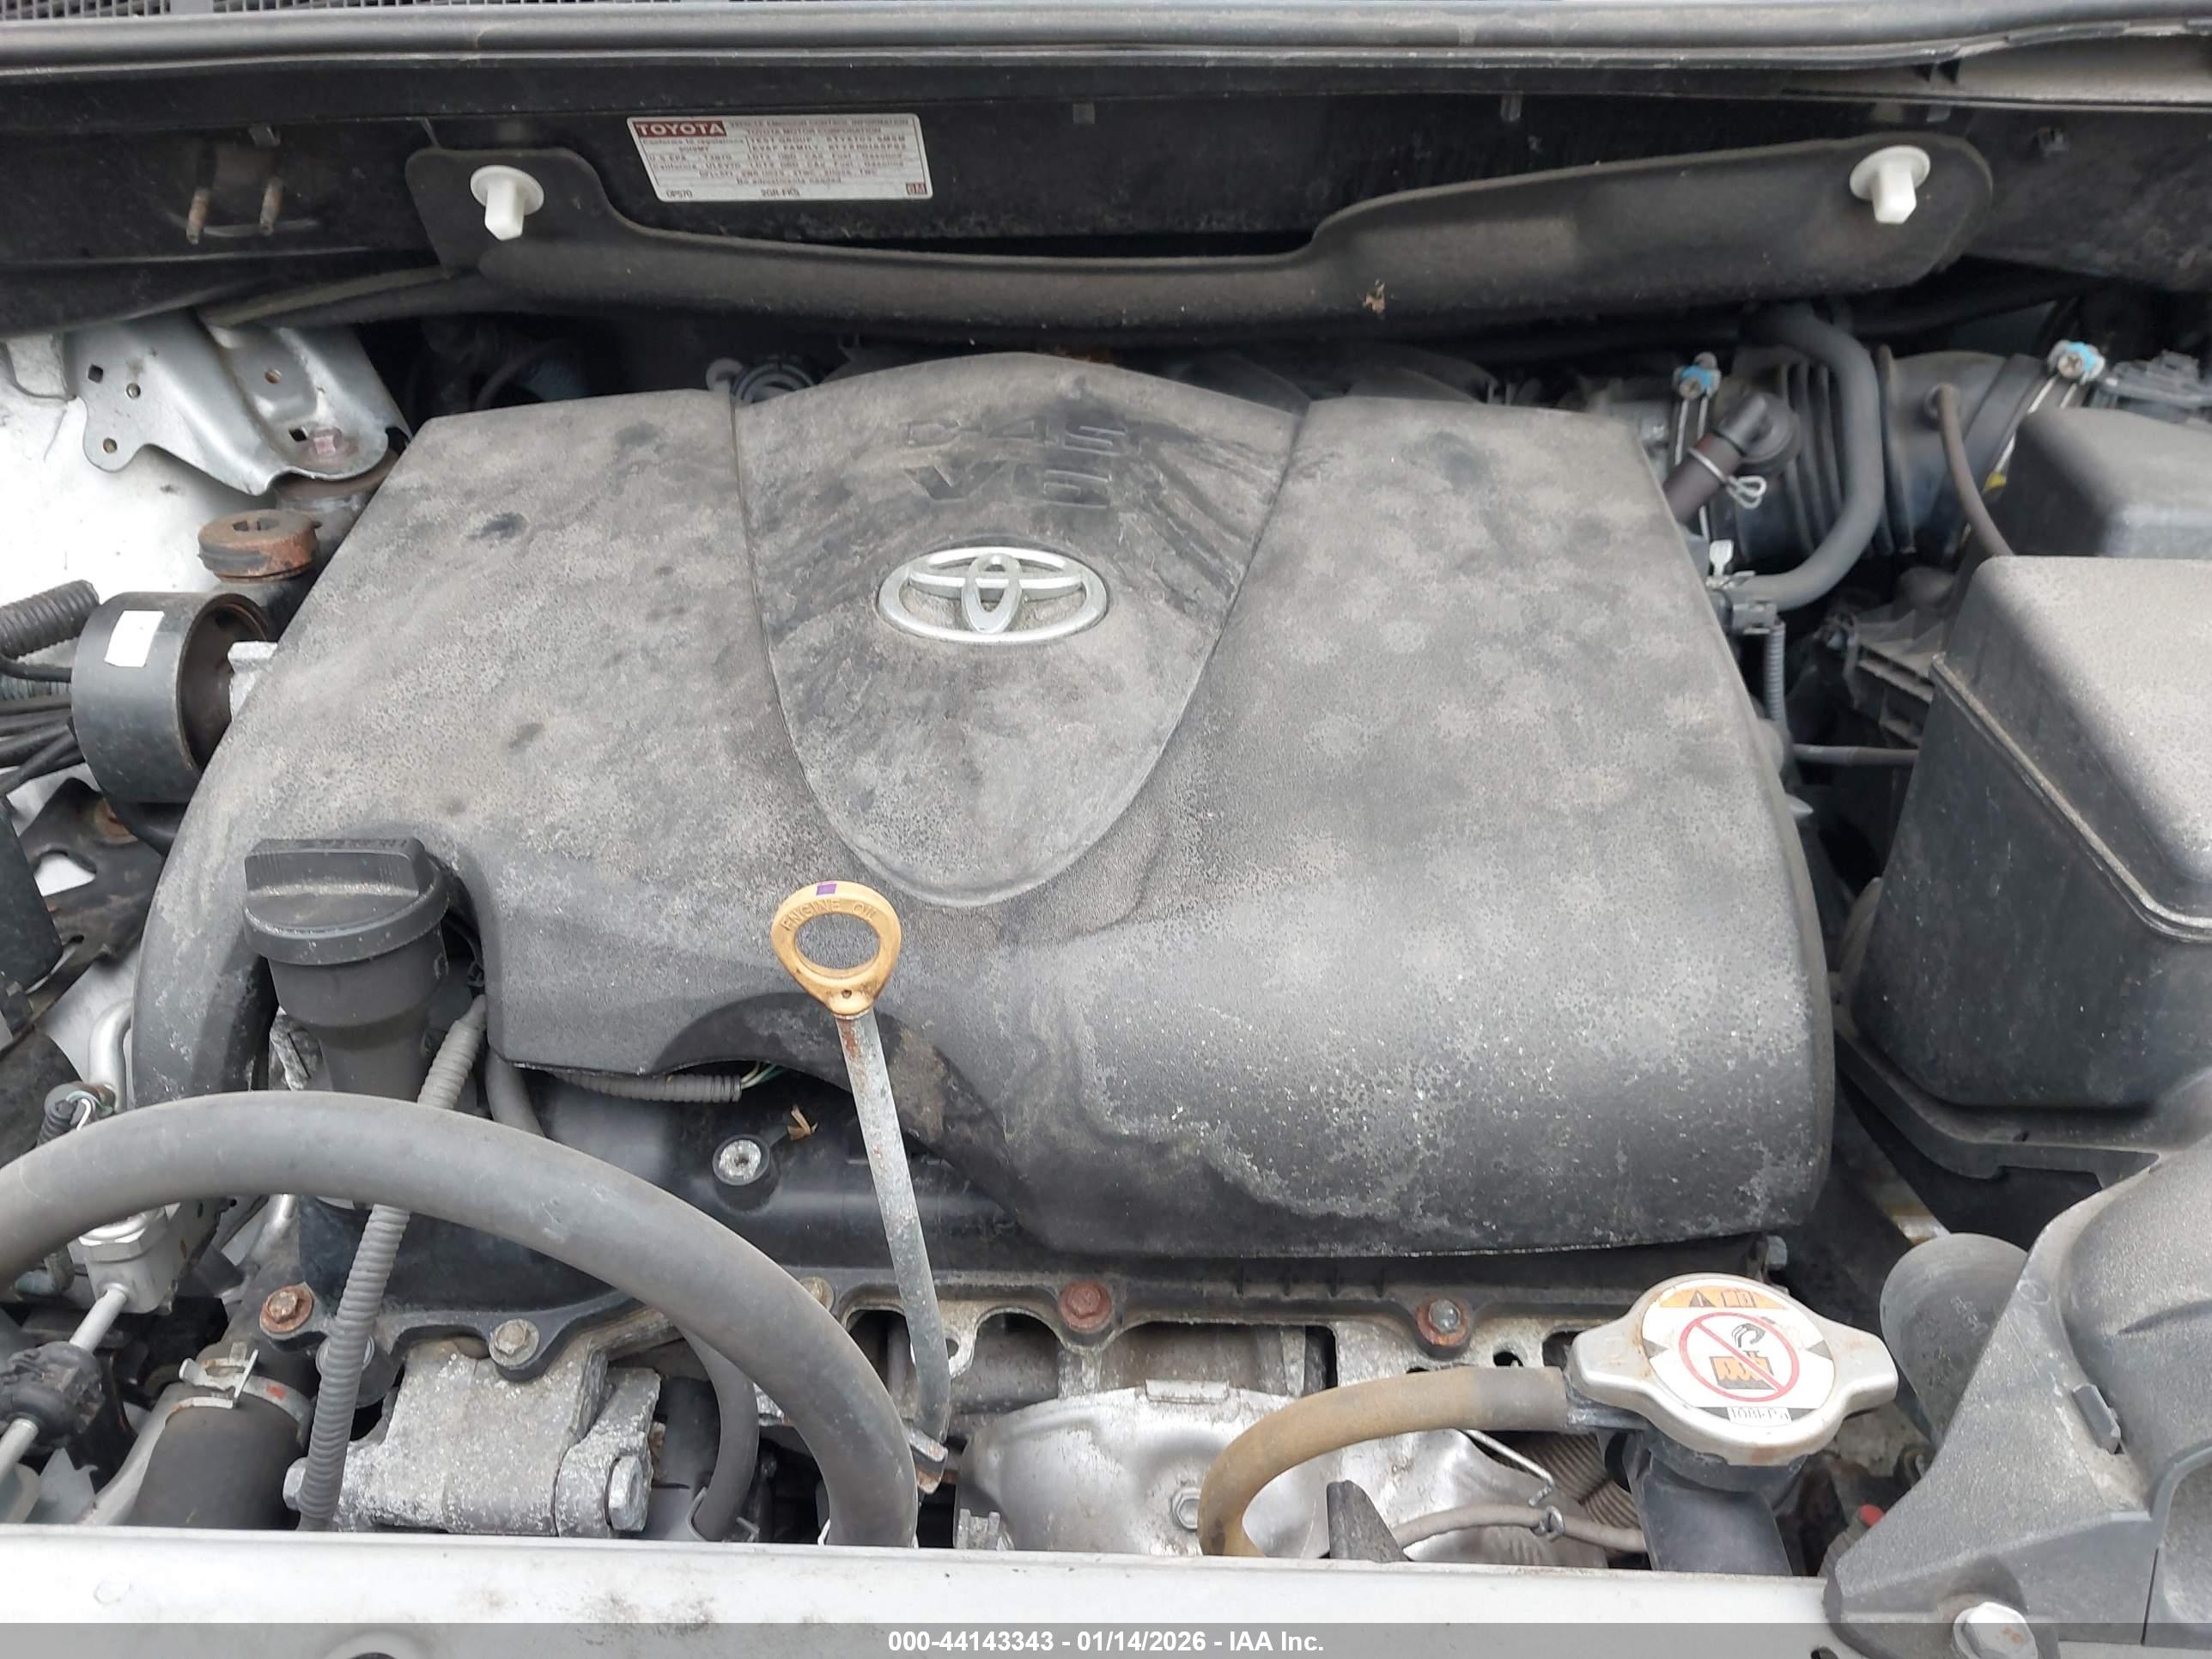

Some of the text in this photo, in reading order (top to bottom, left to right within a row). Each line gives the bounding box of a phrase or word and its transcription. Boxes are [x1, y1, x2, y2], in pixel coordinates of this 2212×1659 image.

[635, 123, 725, 136] TOYOTA
[780, 899, 878, 932] ENGINE OIL
